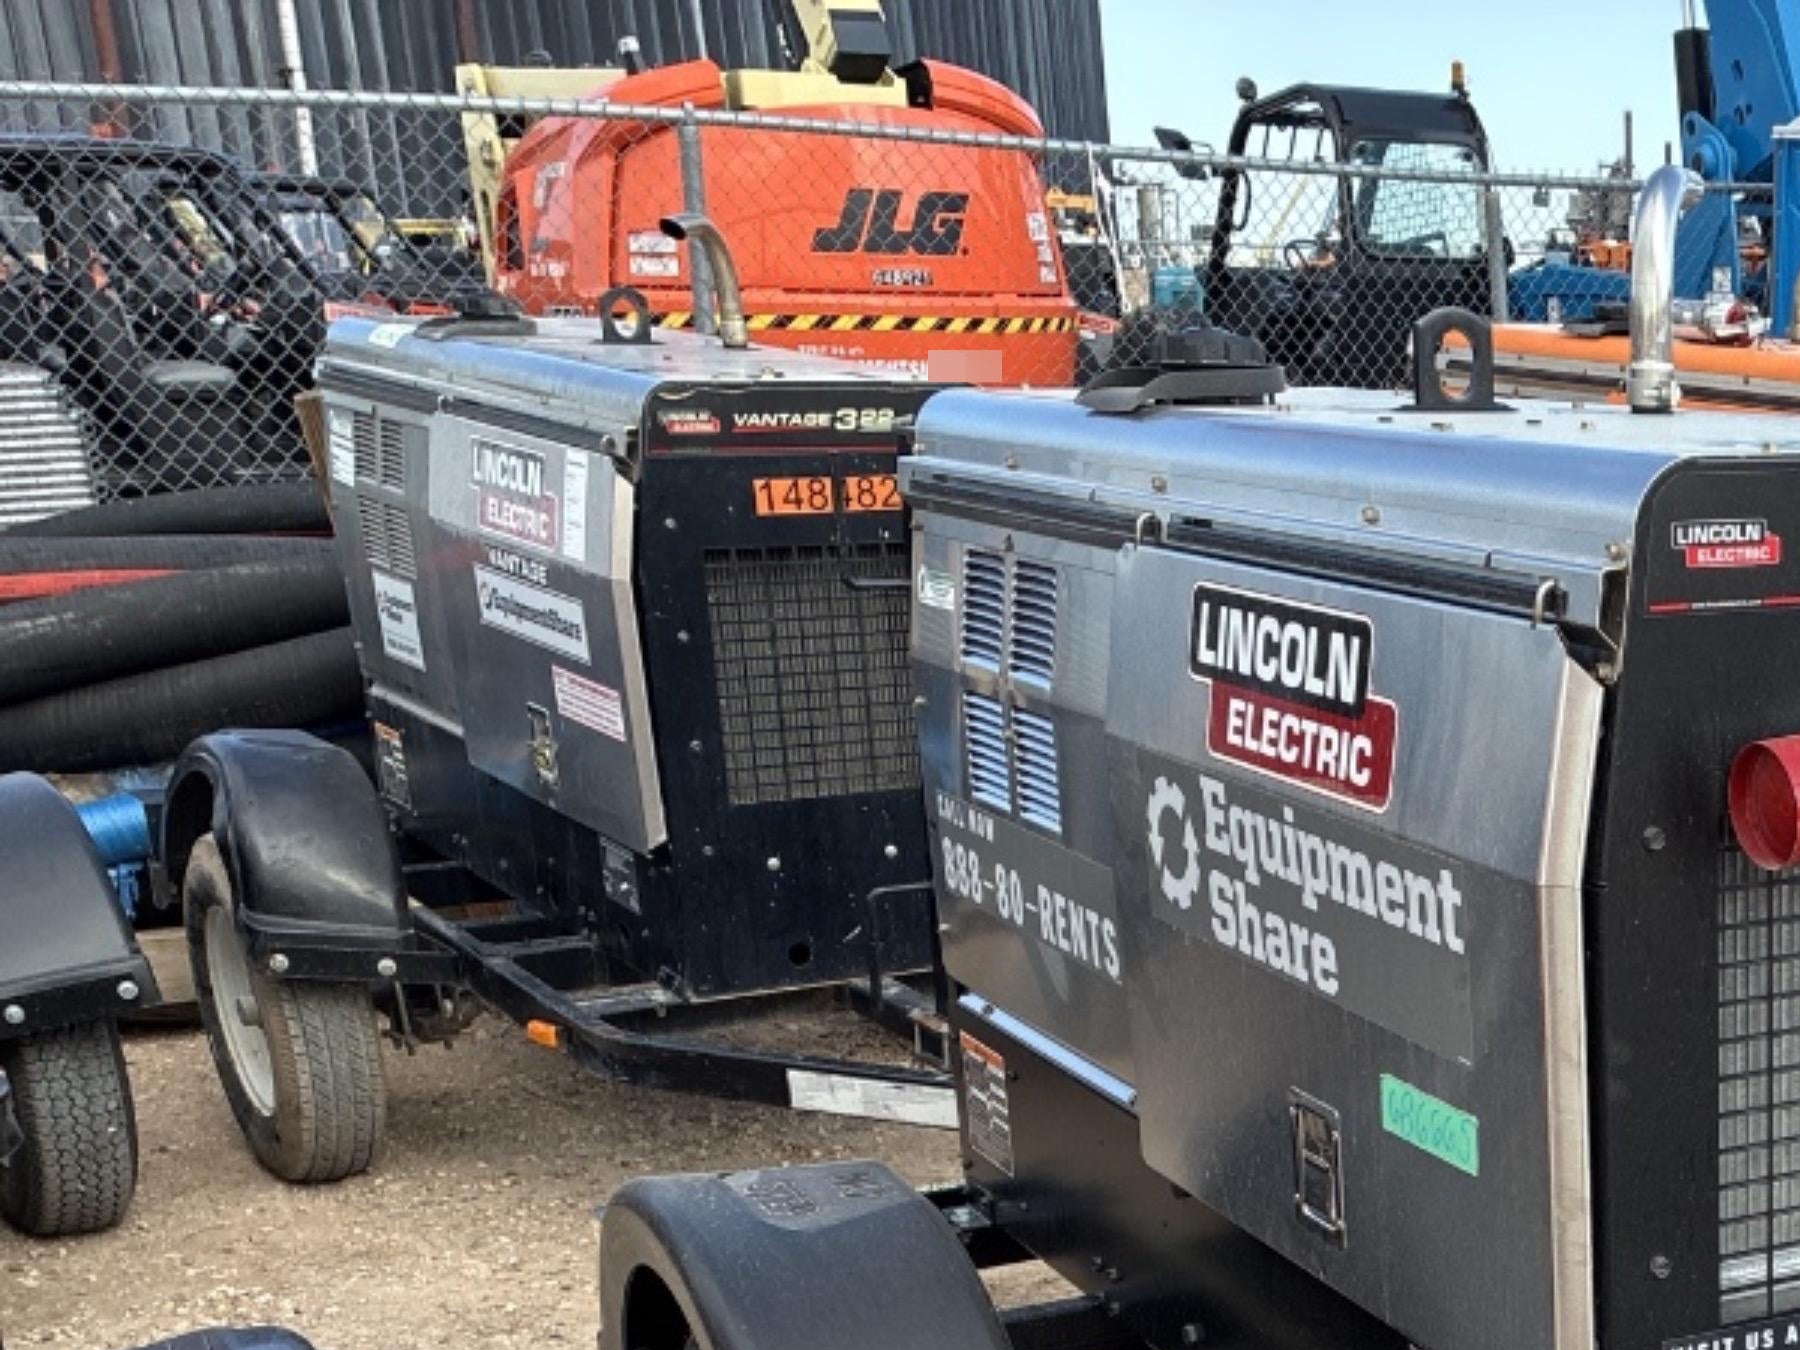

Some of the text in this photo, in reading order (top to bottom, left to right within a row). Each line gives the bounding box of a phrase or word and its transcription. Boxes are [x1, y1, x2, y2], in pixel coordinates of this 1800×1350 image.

[811, 188, 968, 255] JLG
[732, 412, 832, 428] VANTAGE
[472, 446, 542, 498] LINCOLN
[487, 497, 550, 539] ELECTRIC
[1676, 524, 1761, 546] LINCOLN
[1696, 546, 1771, 563] ELECTRIC
[1197, 602, 1361, 706] LINCOLN
[1226, 698, 1372, 788] ELECTRIC
[1200, 774, 1464, 954] Equipment
[941, 836, 1121, 980] 888-80-RENTS
[1208, 868, 1340, 998] Share
